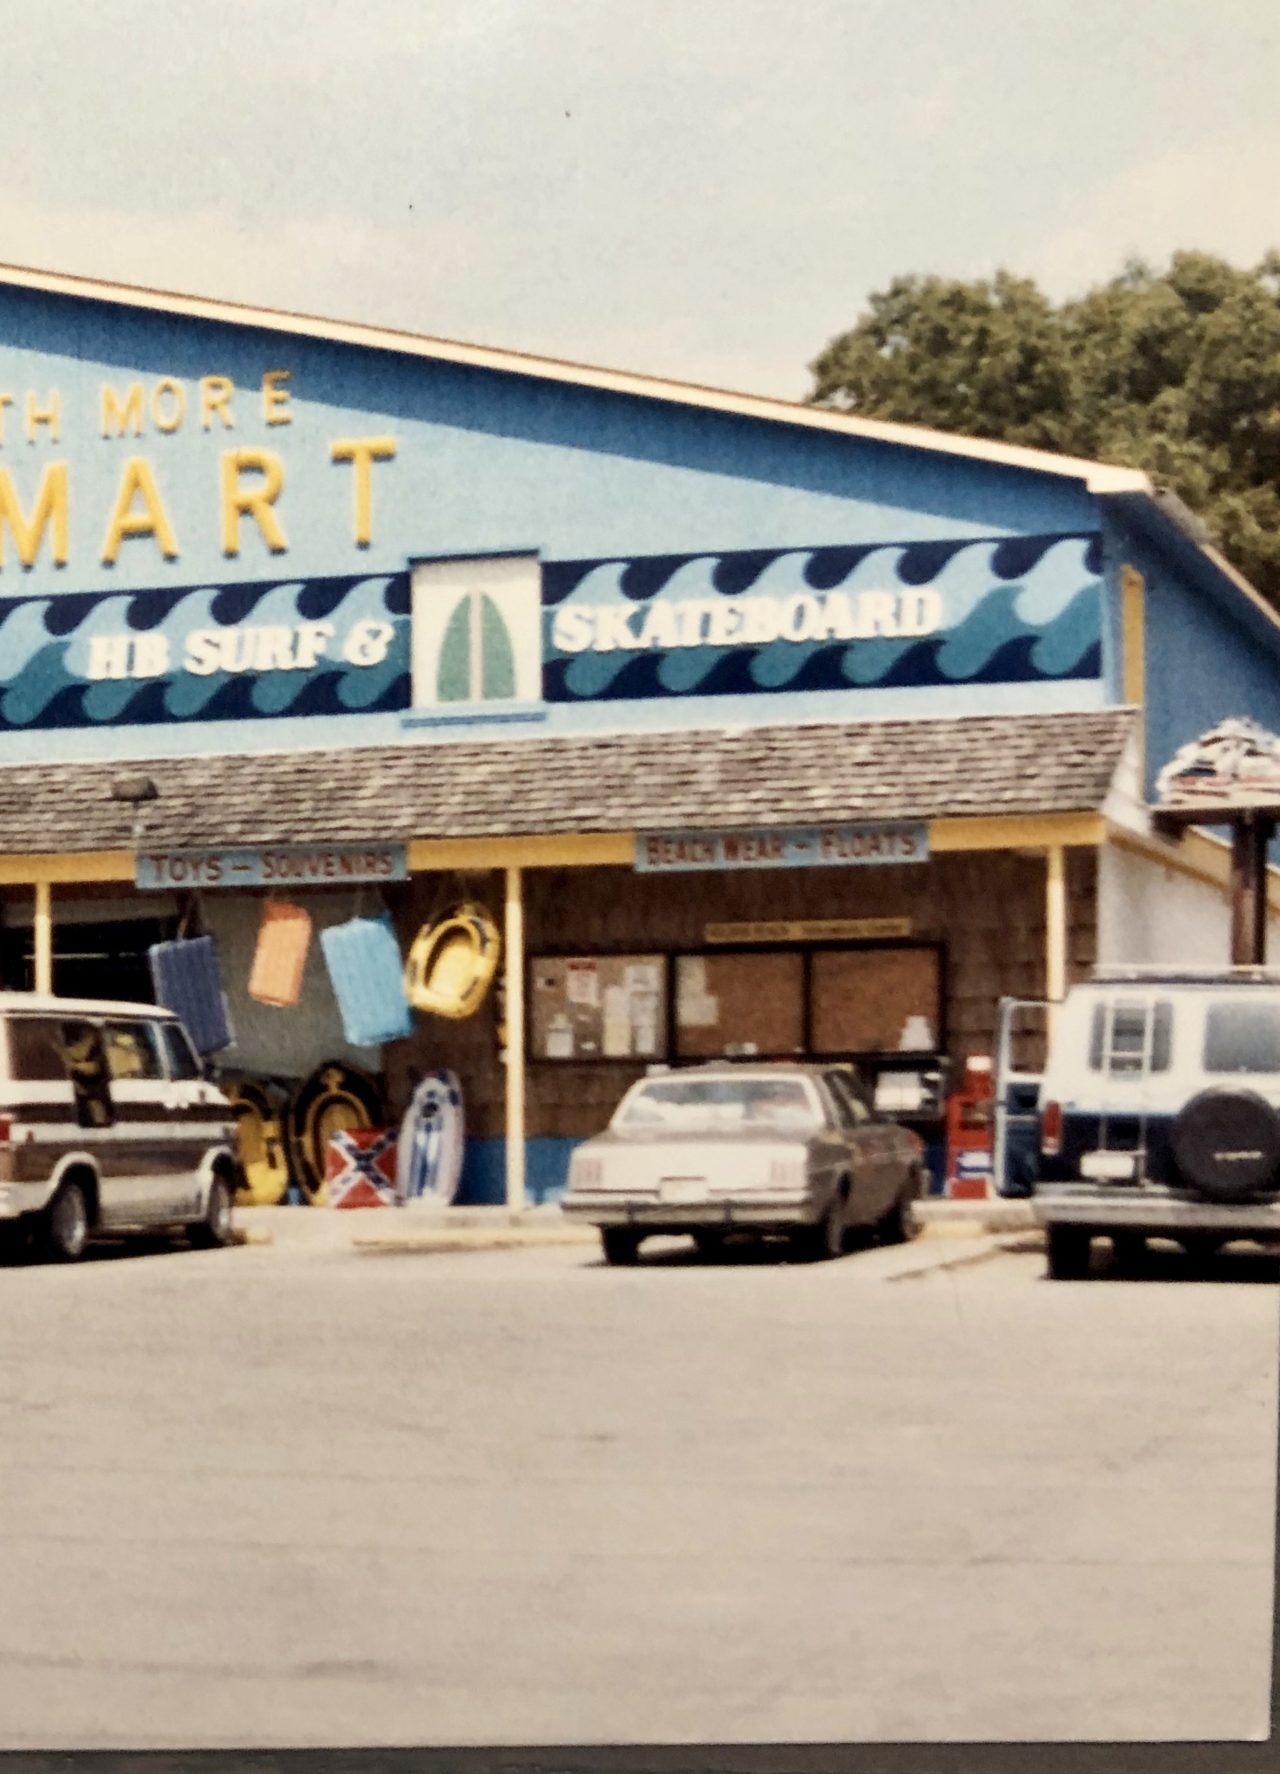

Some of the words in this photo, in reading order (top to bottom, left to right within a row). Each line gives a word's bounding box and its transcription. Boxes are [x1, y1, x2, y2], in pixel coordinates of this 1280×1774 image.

[99, 369, 294, 439] MORE
[86, 633, 171, 680] HB
[184, 622, 333, 676] SURF
[342, 619, 395, 668] &
[550, 588, 943, 653] SKATEBOARD
[148, 853, 222, 882] TOYS
[260, 850, 394, 879] SOUVENIRS
[646, 834, 715, 866] BEACH
[723, 830, 785, 861] WEAR
[821, 828, 917, 858] FLOATS
